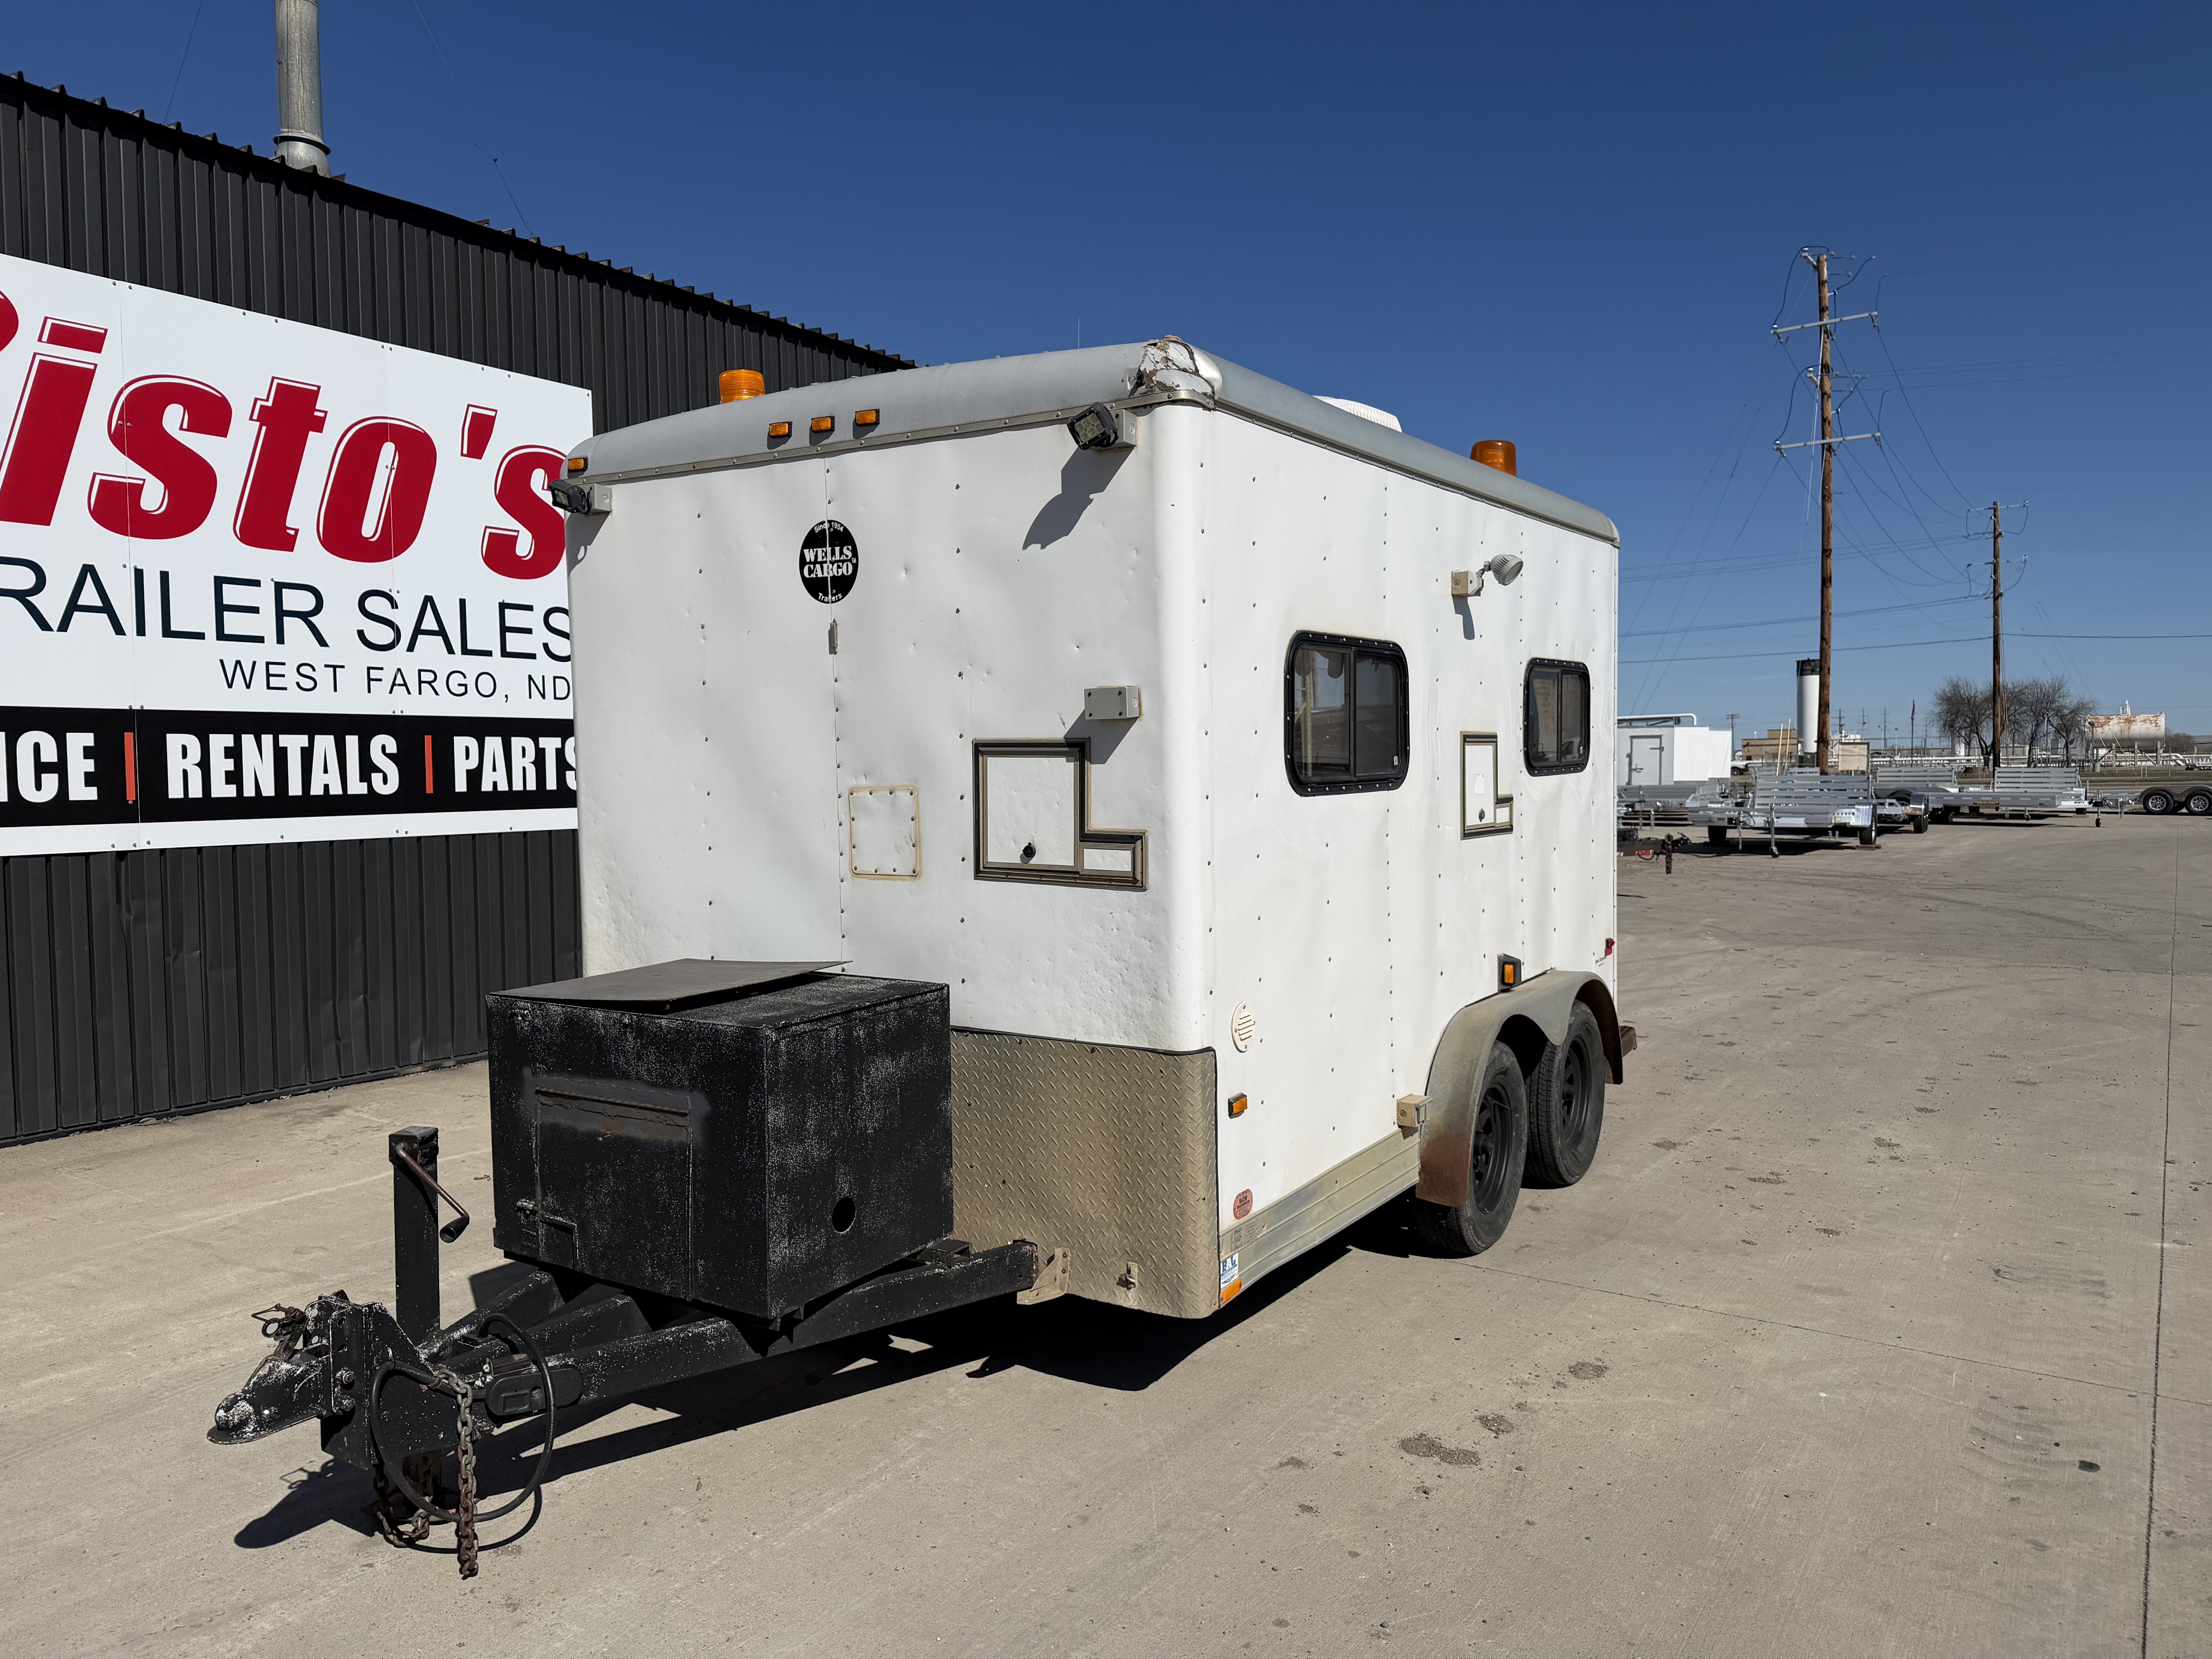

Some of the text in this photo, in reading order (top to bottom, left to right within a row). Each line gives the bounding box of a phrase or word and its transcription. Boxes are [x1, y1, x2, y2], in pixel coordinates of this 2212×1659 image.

[0, 290, 566, 579] isto's
[814, 522, 843, 533] Since 1954
[804, 546, 852, 562] WELLS
[804, 562, 853, 578] CARGO
[357, 589, 571, 662] SALES
[219, 659, 570, 703] WEST FARGO, ND
[166, 733, 399, 799] RENTALS
